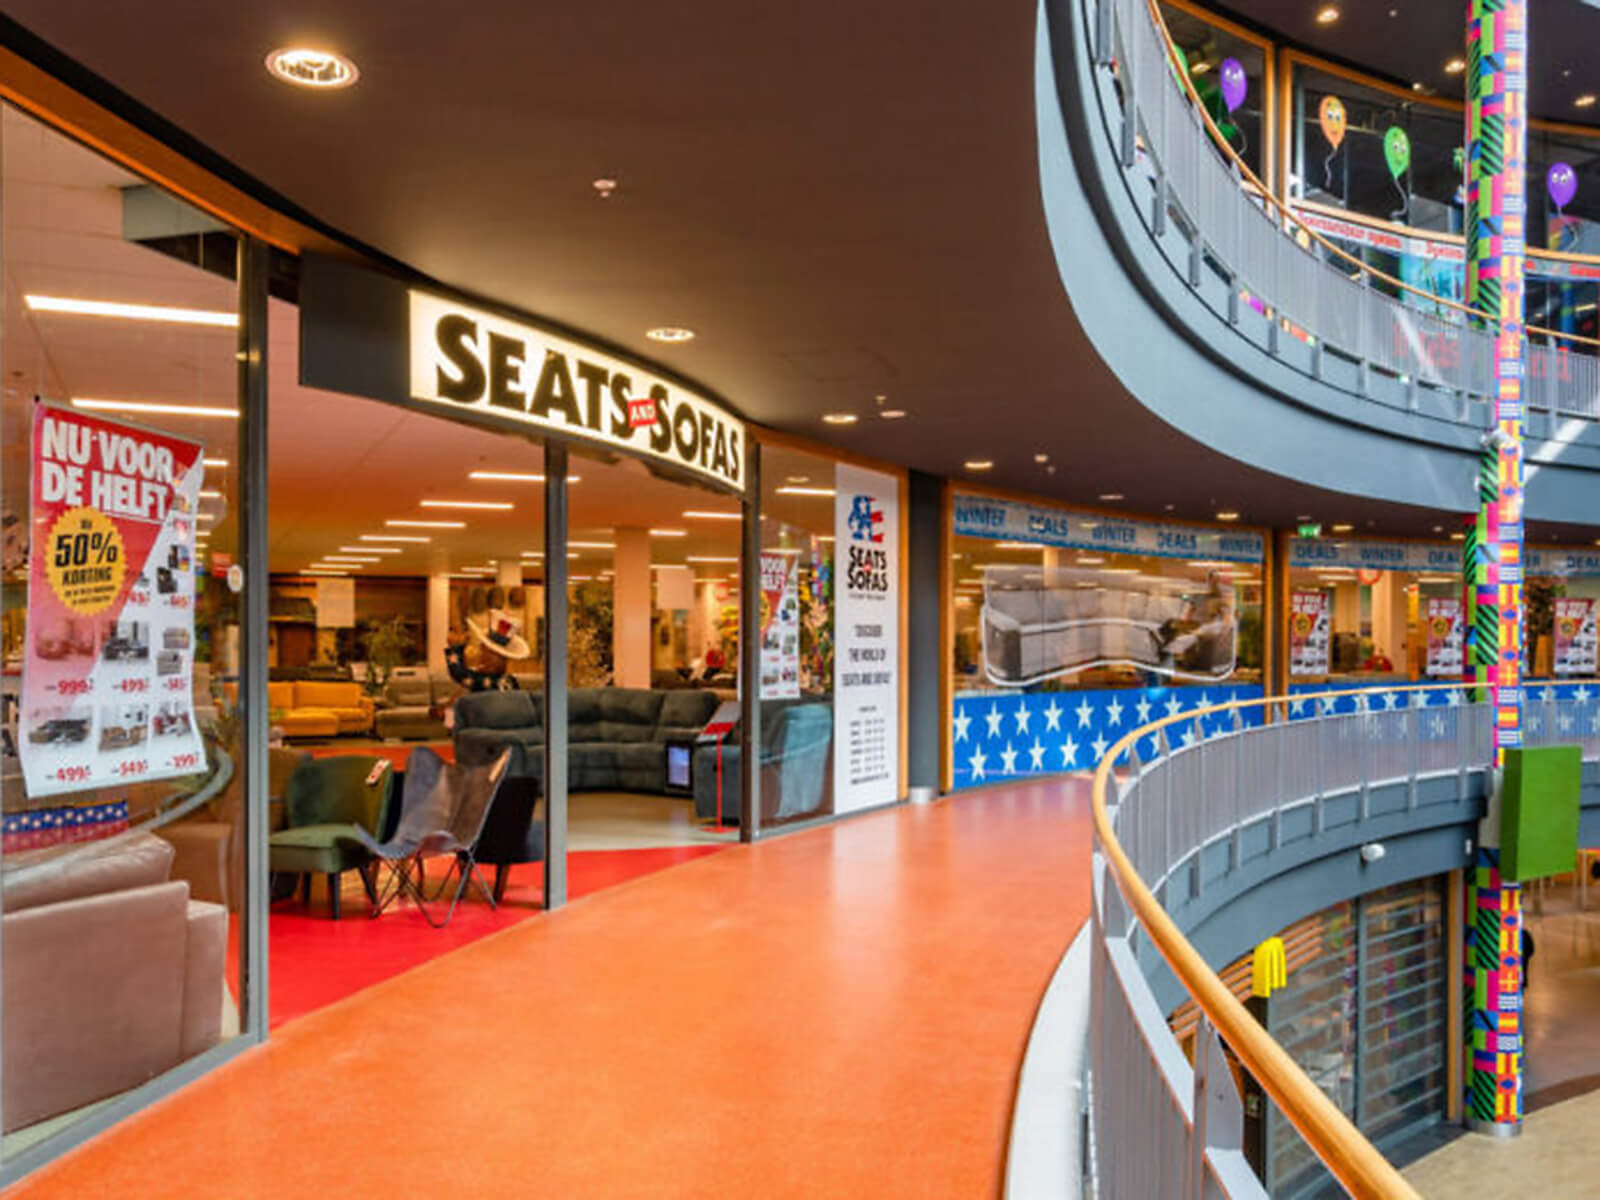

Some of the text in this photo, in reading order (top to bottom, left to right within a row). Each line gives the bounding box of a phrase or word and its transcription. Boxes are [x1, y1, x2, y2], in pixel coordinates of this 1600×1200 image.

[435, 312, 739, 483] SEATS AND SOFAS
[42, 416, 175, 484] NU VOOR
[42, 461, 169, 522] DE HELFT
[954, 505, 1006, 526] WINTER
[1157, 531, 1197, 549] DEALS
[54, 531, 118, 568] 50%
[848, 546, 887, 570] SEATS
[847, 566, 888, 592] SOFAS
